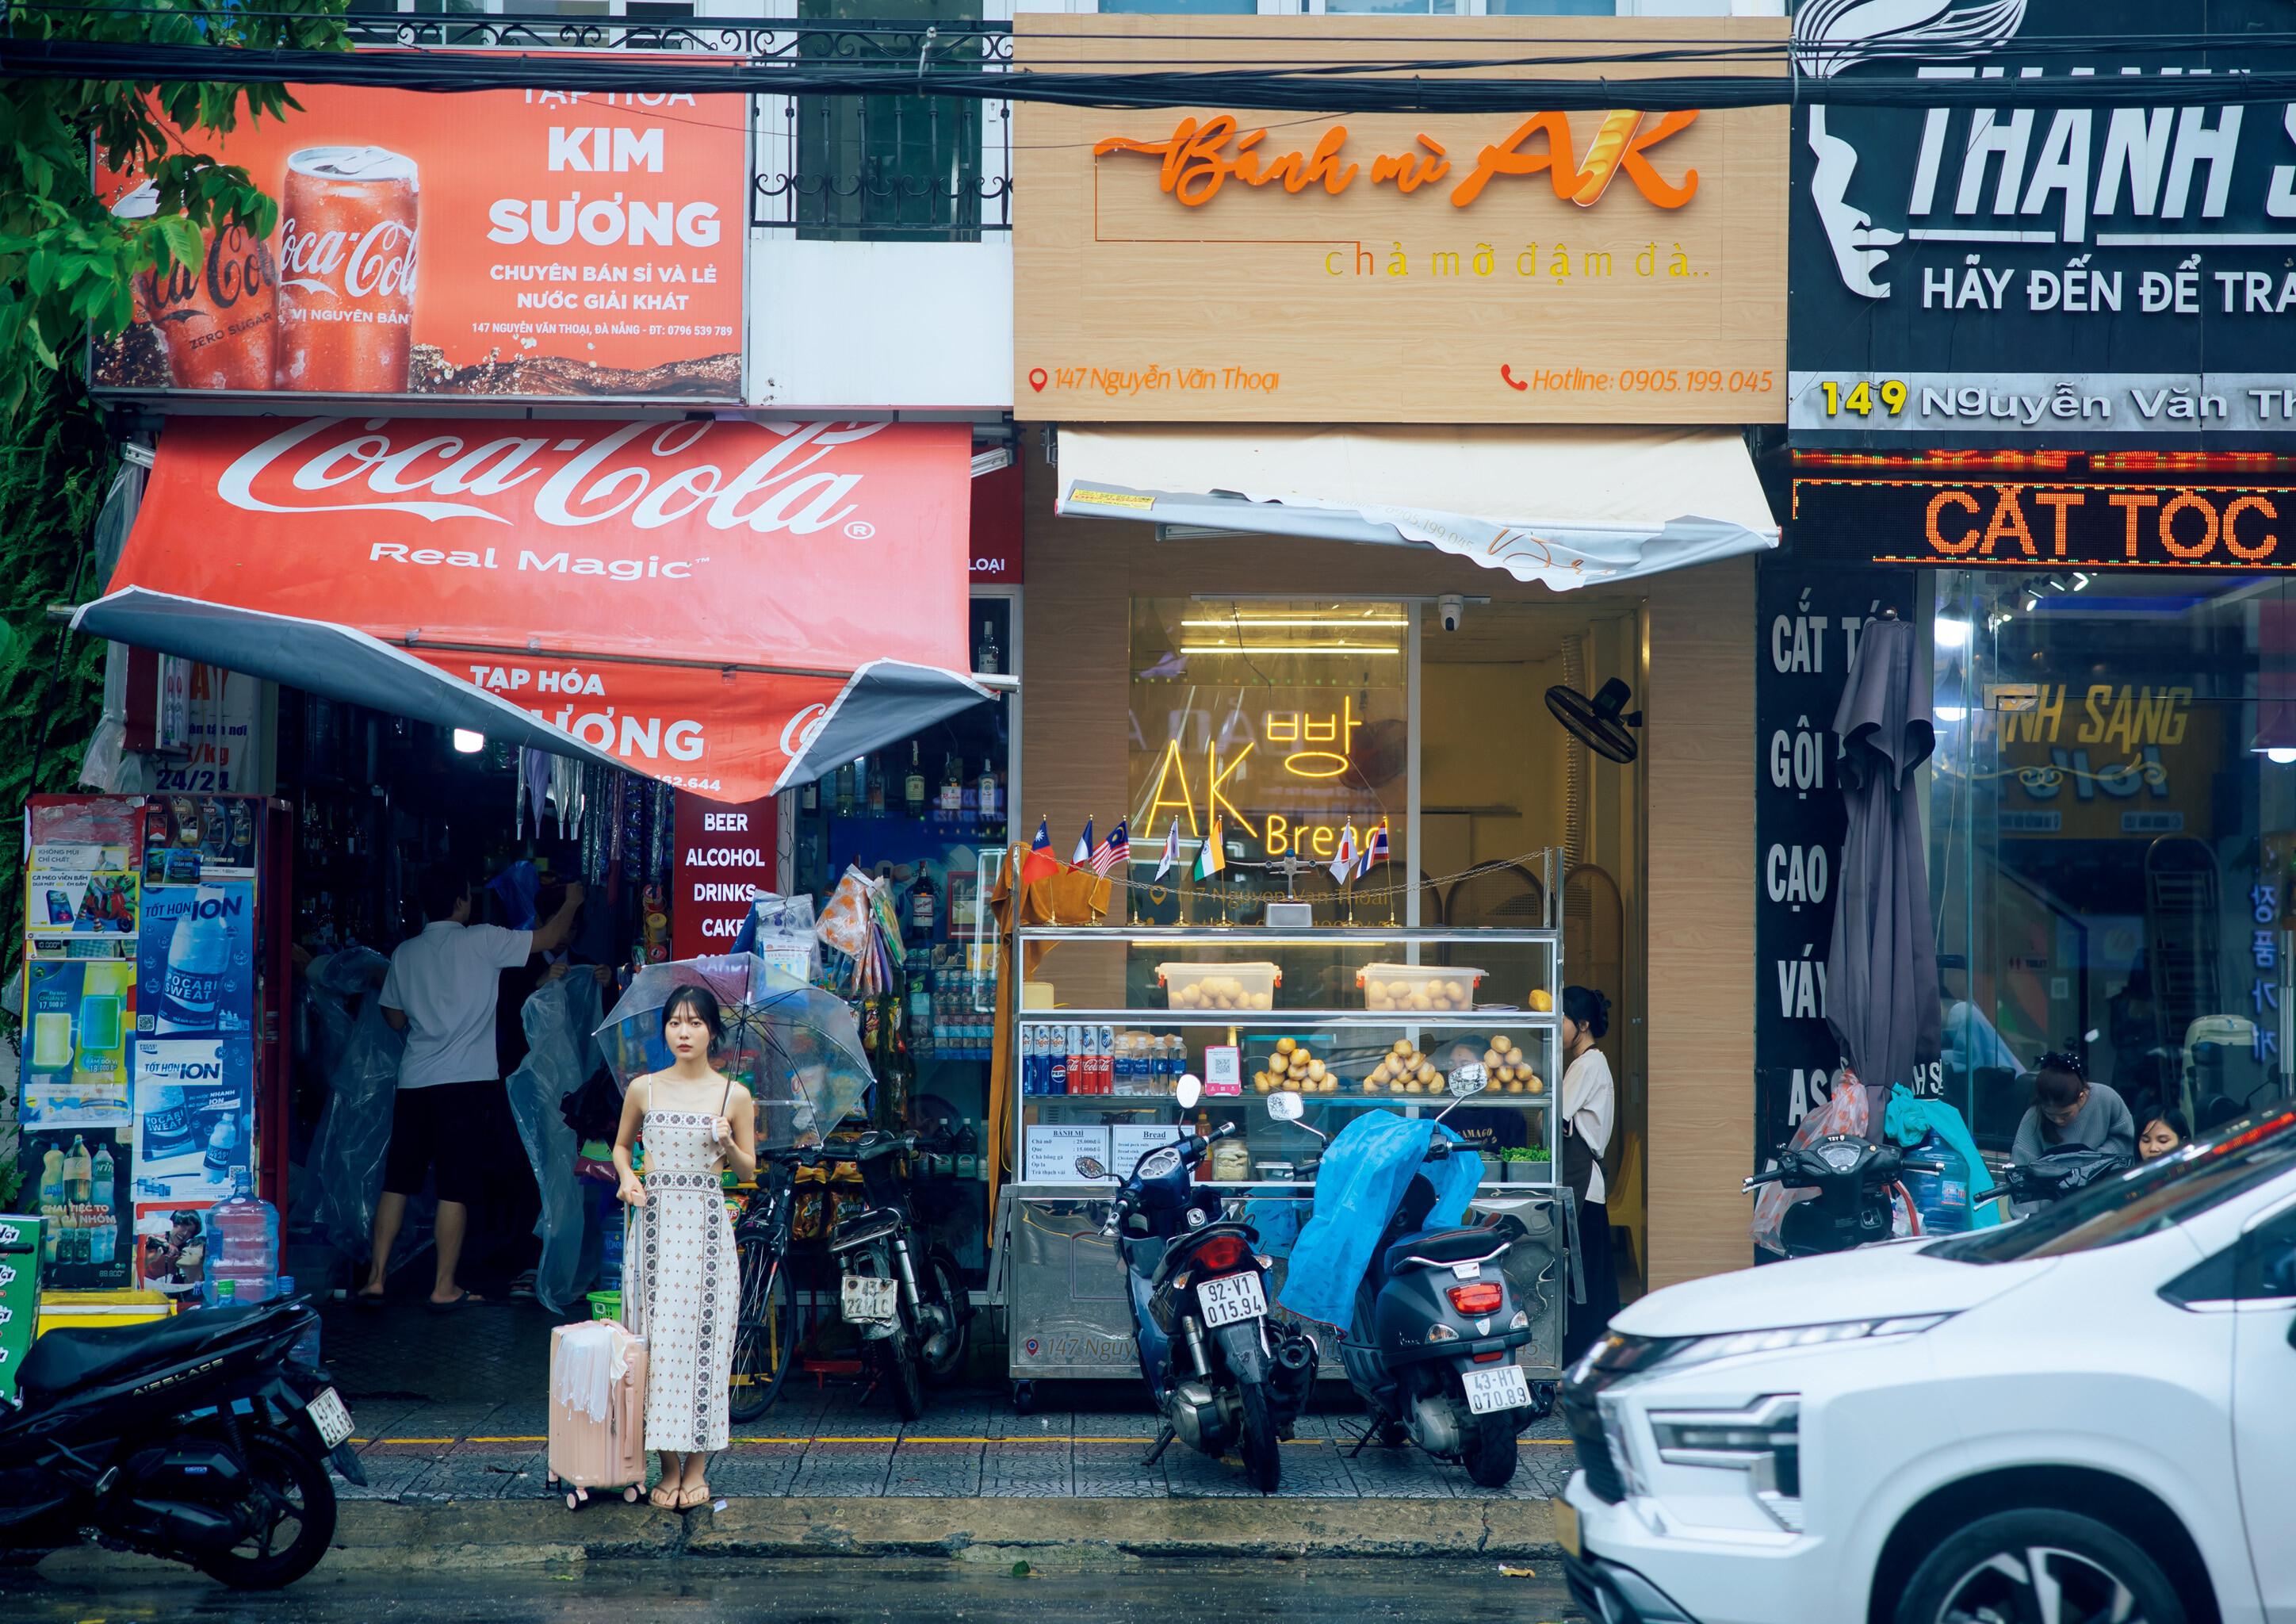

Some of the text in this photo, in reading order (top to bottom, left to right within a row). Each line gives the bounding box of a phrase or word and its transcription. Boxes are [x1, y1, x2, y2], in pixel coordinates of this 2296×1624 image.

[549, 127, 664, 172] KIM
[1095, 115, 1358, 206] Bánh
[1372, 133, 1451, 193] mì
[487, 191, 721, 247] SƯƠNG
[490, 262, 717, 283] CHUYÊN BÁN SỈ VÀ LẺ
[1326, 241, 1408, 277] chả
[1432, 243, 1495, 278] mỡ
[1517, 243, 1613, 285] đậm
[1923, 254, 2202, 313] HÃY ĐẾN ĐỂ
[518, 290, 689, 310] NƯỚC GIẢI KHÁT
[292, 308, 408, 324] VỊ NGUYÊN BẢN
[472, 320, 733, 336] 147 NGUYỄN VĂN THOẠI, ĐÀ NẴNG ĐT: 0796 539 789
[189, 312, 272, 350] ZERO SUGAR
[1054, 365, 1280, 396] 147 Nguyễn Văn Thoại
[1533, 370, 1615, 392] Hotline:
[1823, 381, 1908, 416] 149
[1922, 382, 2110, 424] Nguyễn
[2131, 386, 2228, 418] Văn
[217, 420, 864, 536] Coca-Cola
[1386, 507, 1474, 552] 0905.199.045
[369, 542, 499, 571] Real
[1772, 587, 1828, 673] CẮT
[470, 665, 607, 696] TẠP HÓA
[2077, 684, 2194, 753] SANG
[1267, 695, 1362, 778] 빵
[1770, 714, 1823, 799] GỘI
[155, 769, 229, 791] 24/24
[1145, 738, 1258, 838] AK
[705, 813, 748, 832] BEER
[686, 848, 765, 868] ALCOHOL
[1767, 843, 1827, 912] CẠO
[694, 883, 756, 902] DRINKS
[145, 902, 165, 917] TỐT
[166, 901, 192, 915] HƠN
[191, 895, 243, 921] ION
[164, 982, 212, 1001] SWEAT
[166, 972, 217, 990] POCARI
[1035, 1038, 1049, 1048] Tiger
[145, 1061, 161, 1072] TỐT
[179, 1063, 220, 1079] ION
[209, 1090, 235, 1098] NHANH
[209, 1097, 224, 1106] ION
[147, 1111, 184, 1124] POCARI
[147, 1119, 182, 1132] SWEAT
[79, 1212, 117, 1224] NHÓM
[1208, 1277, 1250, 1302] 92-V1
[1208, 1296, 1261, 1324] 015.94
[1048, 1338, 1078, 1356] 147
[1475, 1370, 1516, 1390] 43-H1
[314, 1394, 339, 1422] 43-H1
[1473, 1388, 1527, 1411] 070.89
